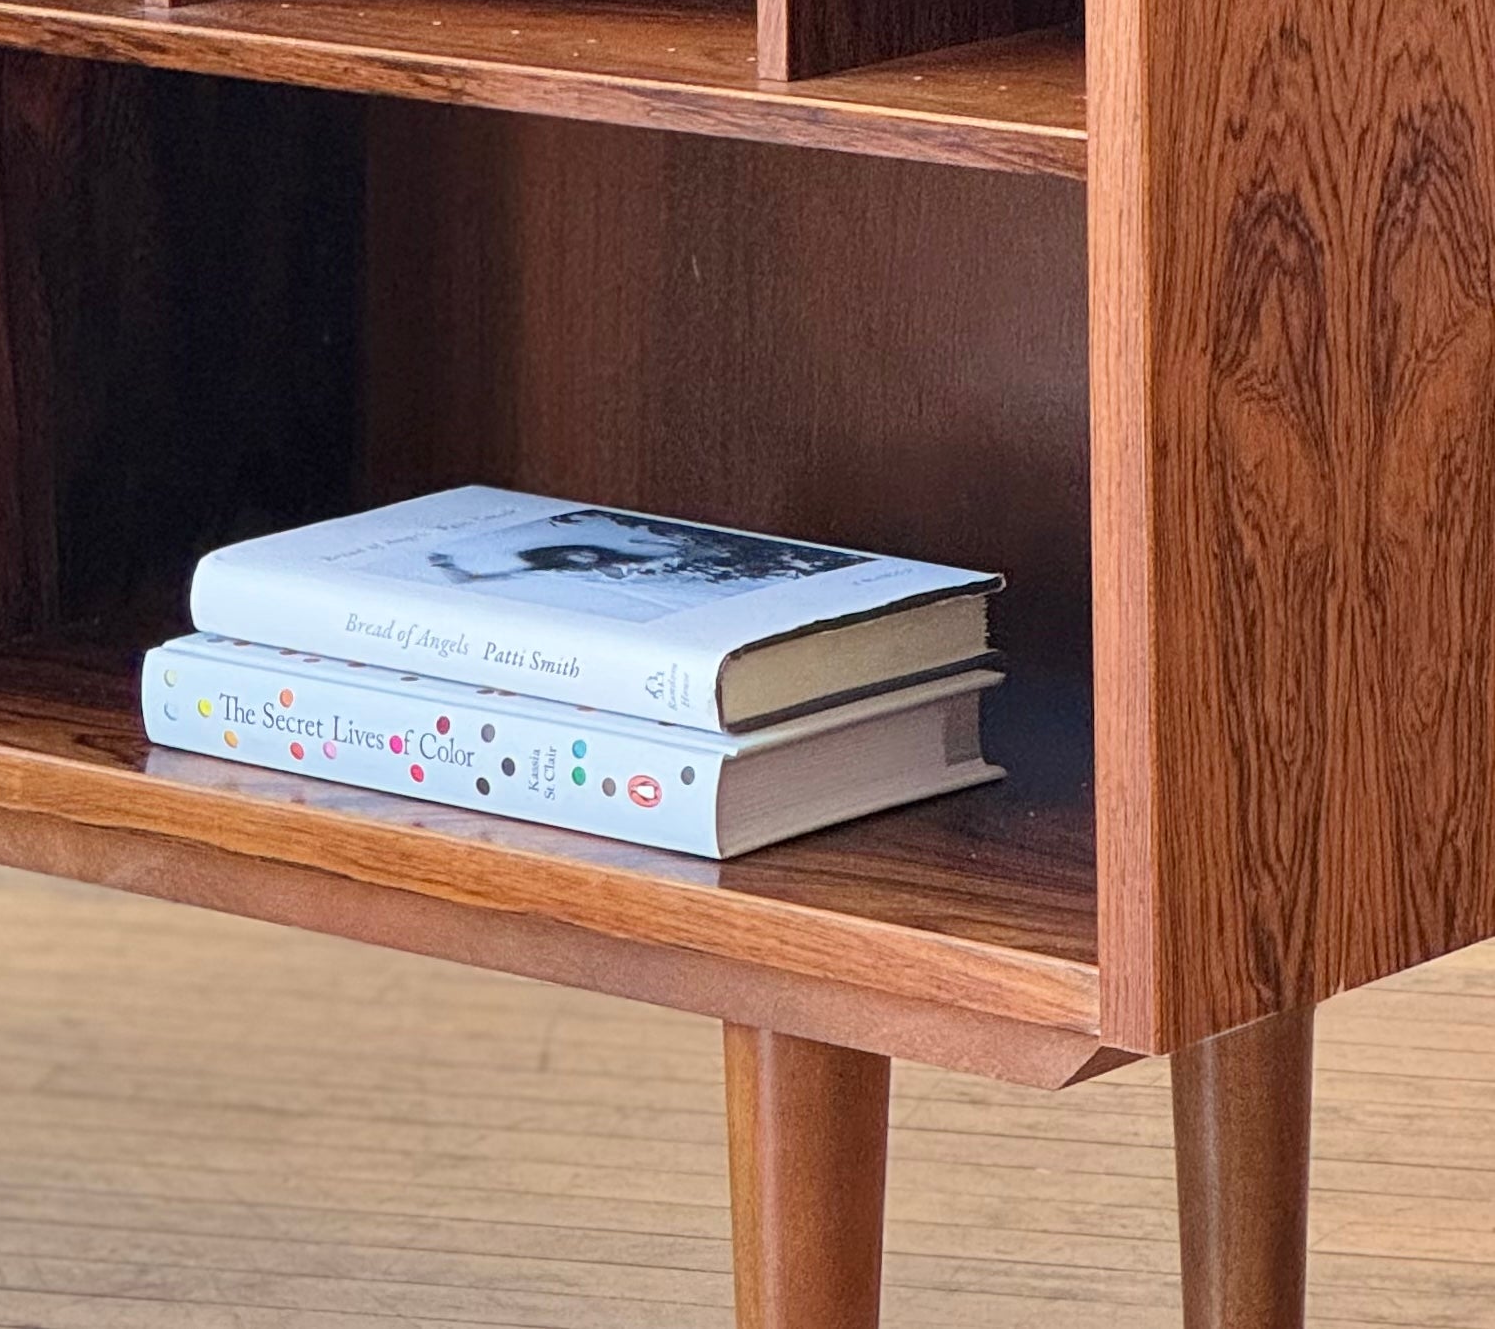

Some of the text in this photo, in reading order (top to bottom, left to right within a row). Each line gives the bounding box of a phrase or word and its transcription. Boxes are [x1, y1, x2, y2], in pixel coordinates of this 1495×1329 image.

[345, 613, 580, 678] Bread of Angels Patti Smith
[219, 693, 255, 725] The
[262, 701, 323, 738] Secret
[333, 715, 385, 750] Lives
[419, 732, 475, 768] Color
[544, 746, 557, 781] Clair
